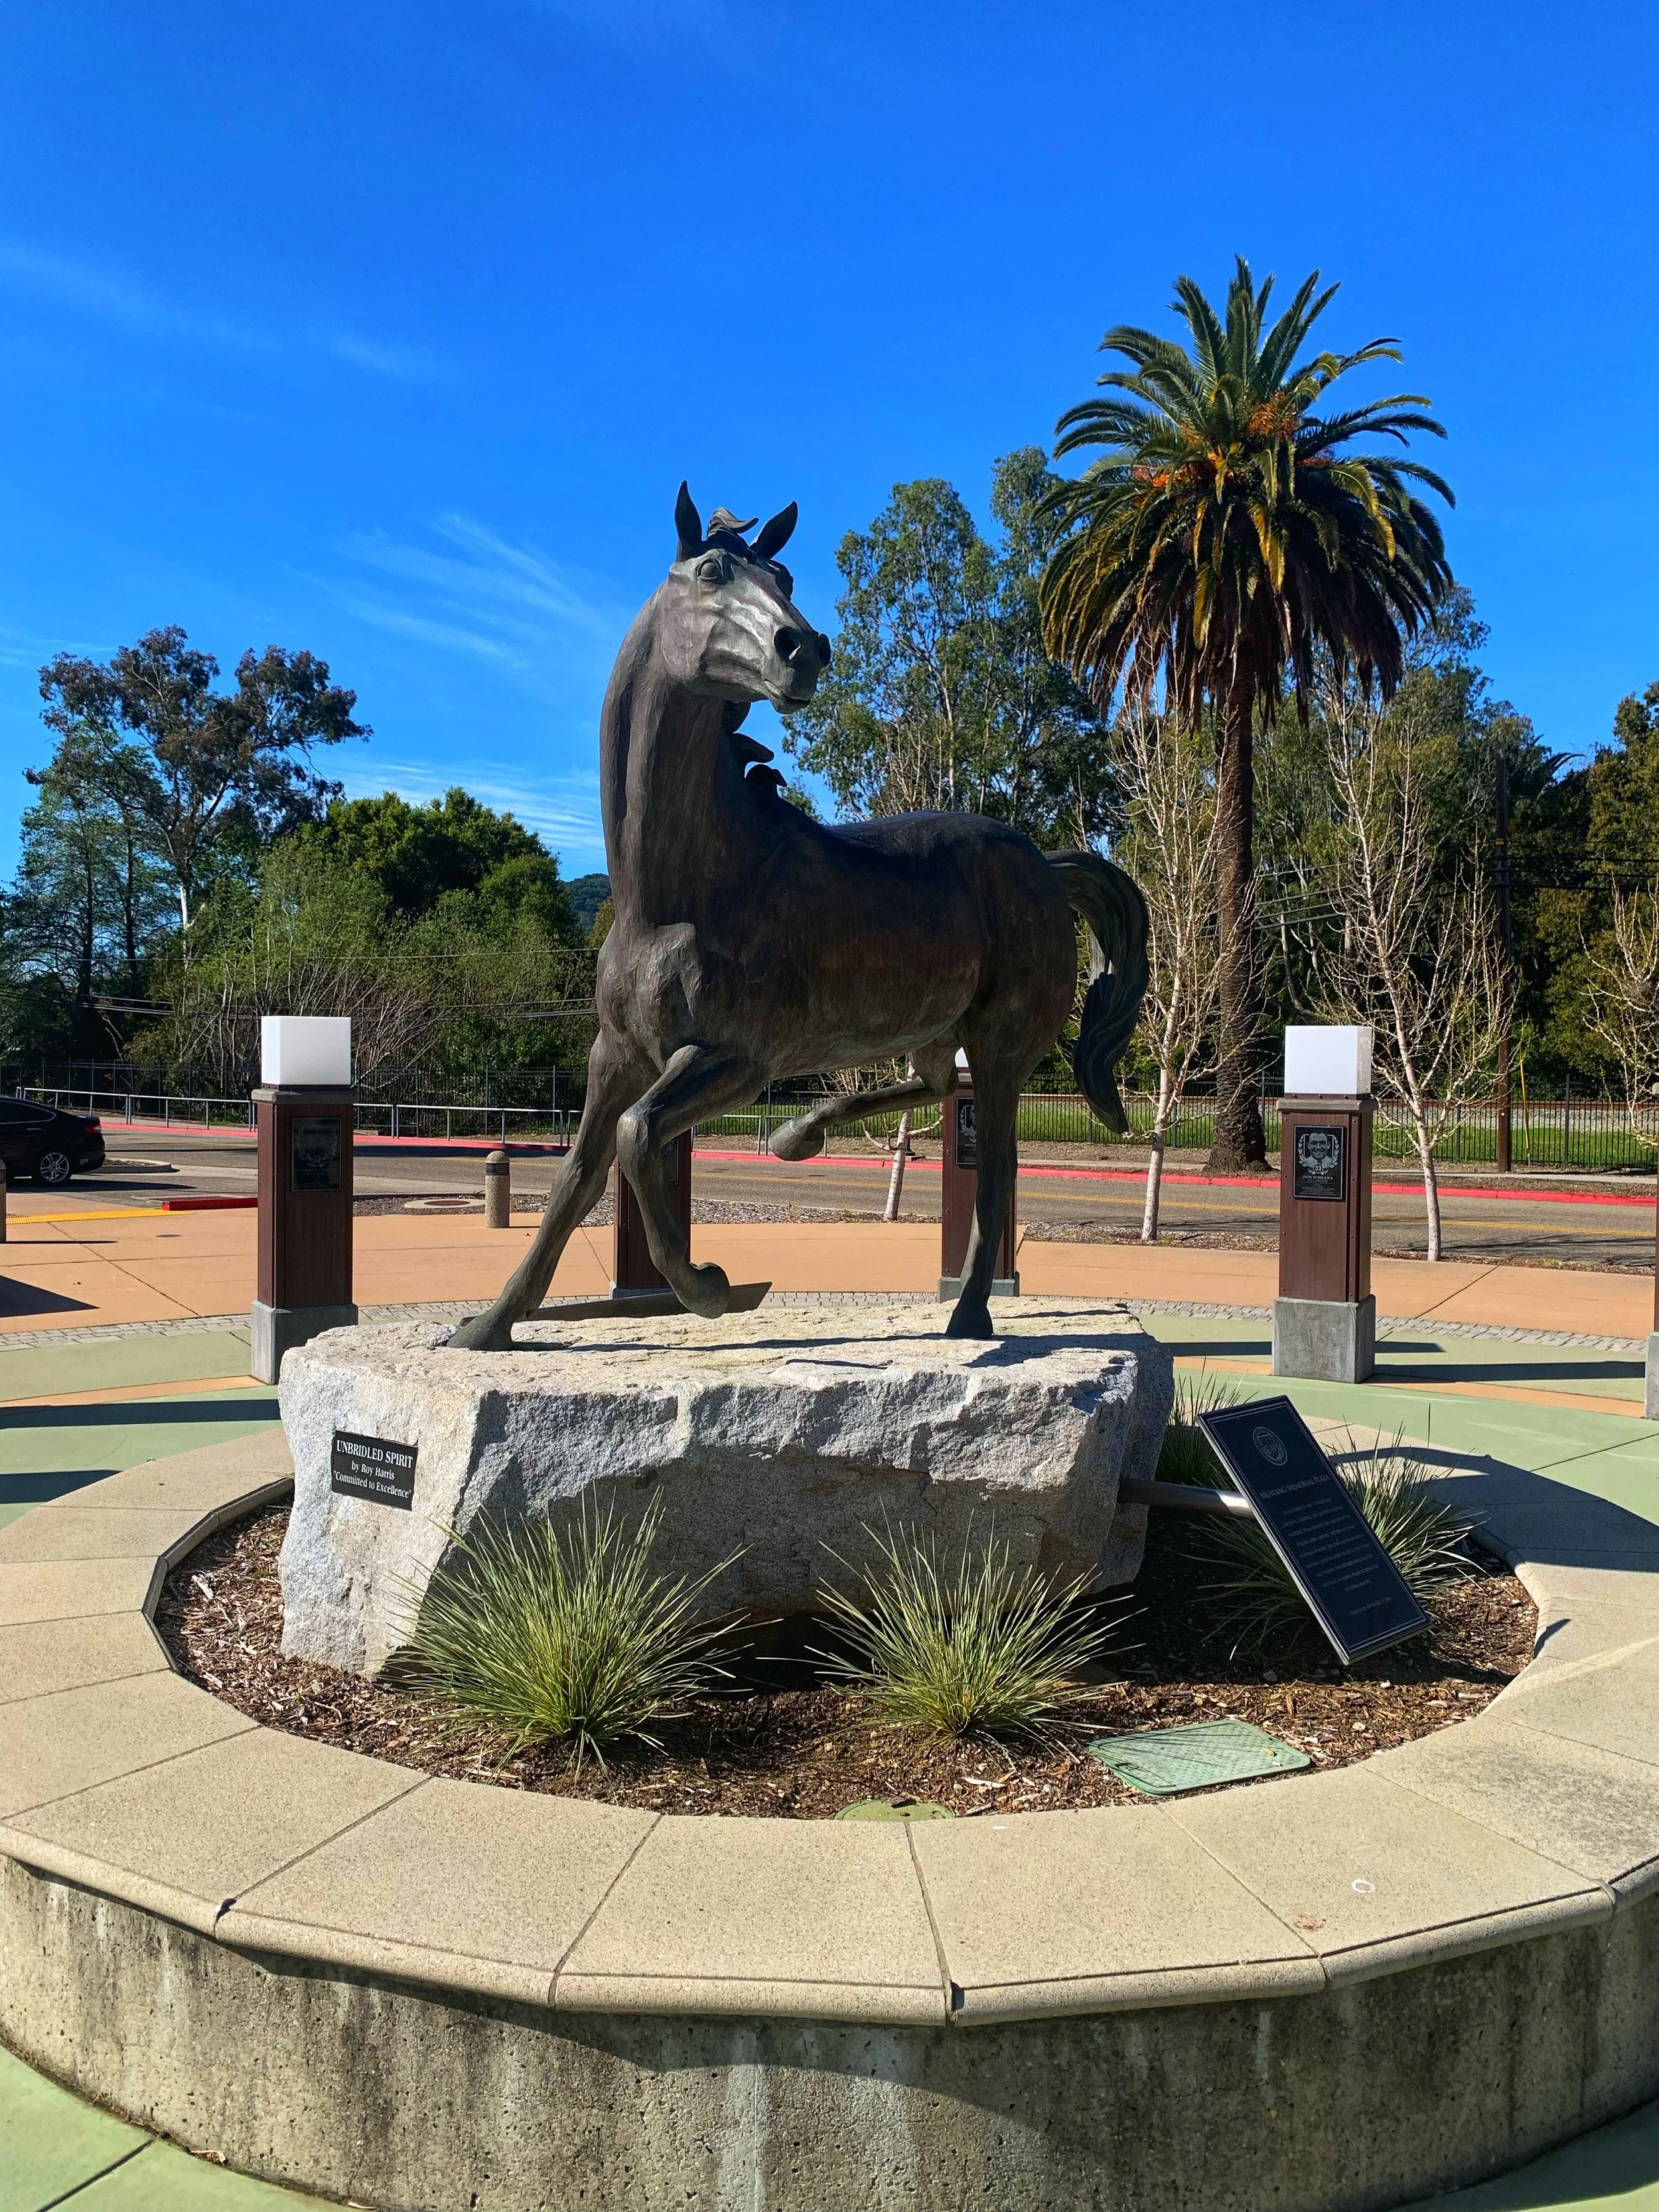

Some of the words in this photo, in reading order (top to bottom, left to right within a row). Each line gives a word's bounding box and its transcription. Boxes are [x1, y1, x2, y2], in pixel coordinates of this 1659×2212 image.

[336, 1439, 384, 1461] UNBRIDLED
[385, 1451, 413, 1469] SPIRIT
[351, 1460, 360, 1473] by
[361, 1463, 374, 1476] Roy
[375, 1467, 395, 1480] Harris
[333, 1470, 368, 1488] "Committed
[368, 1481, 375, 1490] to
[376, 1481, 412, 1499] Excellence"
[1259, 1486, 1287, 1499] MUSTANG
[1286, 1478, 1315, 1491] MEMORIAL
[1313, 1474, 1331, 1483] PLAZA
